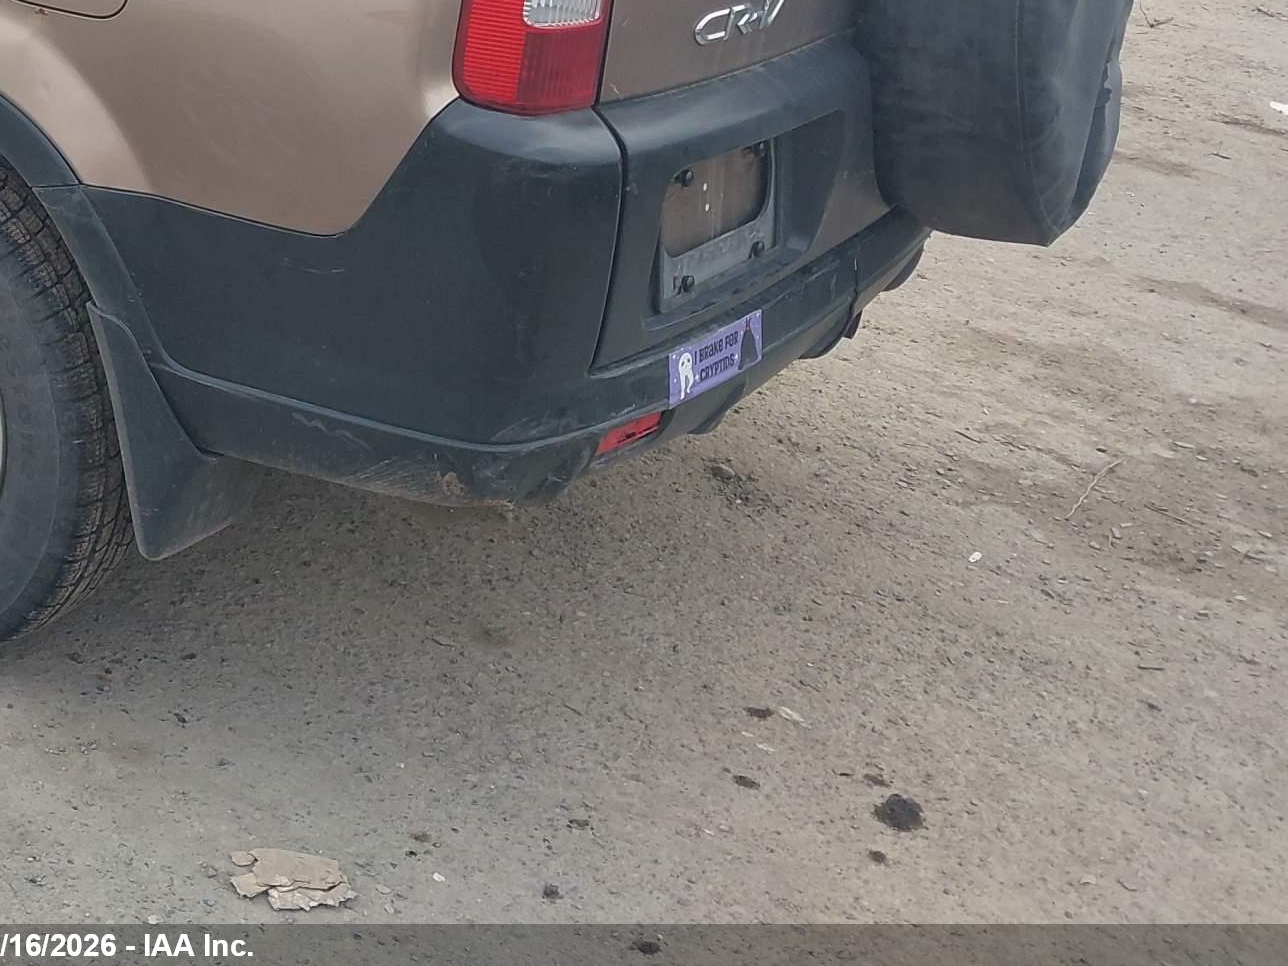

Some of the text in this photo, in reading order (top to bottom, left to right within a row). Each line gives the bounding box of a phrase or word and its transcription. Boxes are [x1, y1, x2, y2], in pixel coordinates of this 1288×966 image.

[694, 350, 698, 365] I
[725, 331, 739, 350] FOR
[699, 353, 735, 381] CRYPTIDS
